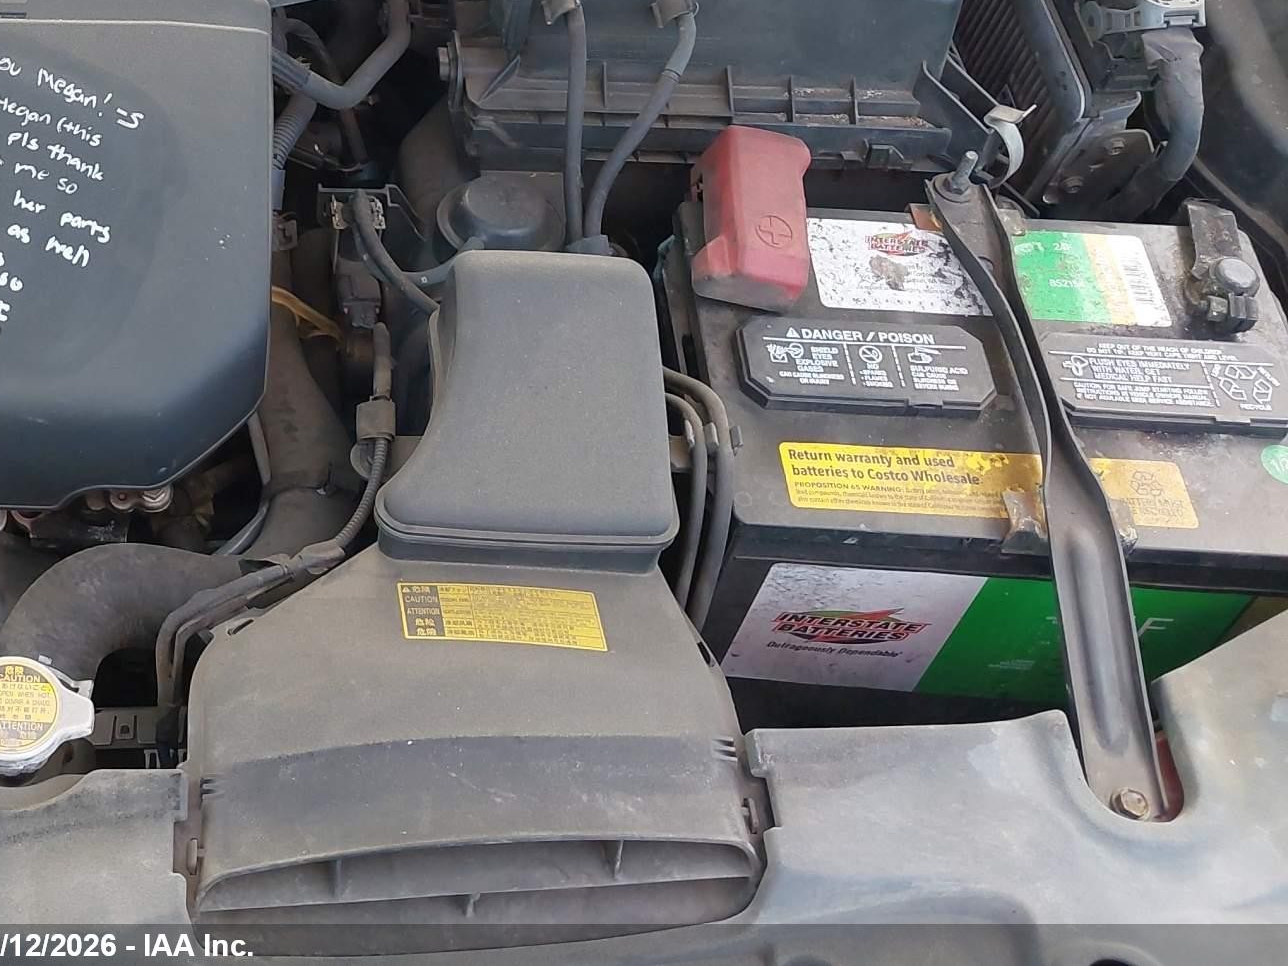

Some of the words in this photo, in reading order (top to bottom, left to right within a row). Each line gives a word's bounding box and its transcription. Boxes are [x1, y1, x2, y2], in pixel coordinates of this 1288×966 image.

[56, 117, 101, 147] (this
[7, 132, 39, 151] pls
[48, 142, 103, 181] thank
[15, 162, 49, 180] me
[57, 177, 77, 195] so
[13, 191, 46, 215] her
[60, 211, 111, 243] parts
[7, 224, 31, 243] as
[45, 236, 90, 267] well
[865, 235, 928, 248] INTERSTATE
[801, 328, 862, 341] DANGER
[866, 331, 874, 342] /
[878, 332, 935, 345] POISON
[795, 358, 838, 367] EXPLOSIVE
[1089, 358, 1113, 366] FLUSH
[1117, 359, 1136, 367] EYES
[1138, 360, 1190, 370] IMMEDIATELY
[1130, 374, 1150, 382] HELP
[1153, 375, 1173, 383] FAST
[788, 448, 832, 461] Return
[835, 453, 892, 468] warranty
[895, 454, 921, 466] and
[924, 456, 955, 468] used
[792, 465, 849, 479] batteries
[852, 470, 865, 480] to
[867, 470, 907, 482] Costco
[794, 481, 849, 490] PROPOSITION
[404, 594, 439, 603] CAUTION
[406, 607, 441, 615] ATTENTION
[778, 613, 922, 633] INTERSTATE
[778, 623, 905, 641] BATTERIES
[767, 641, 836, 654] Outrageously
[17, 690, 34, 698] WHEN
